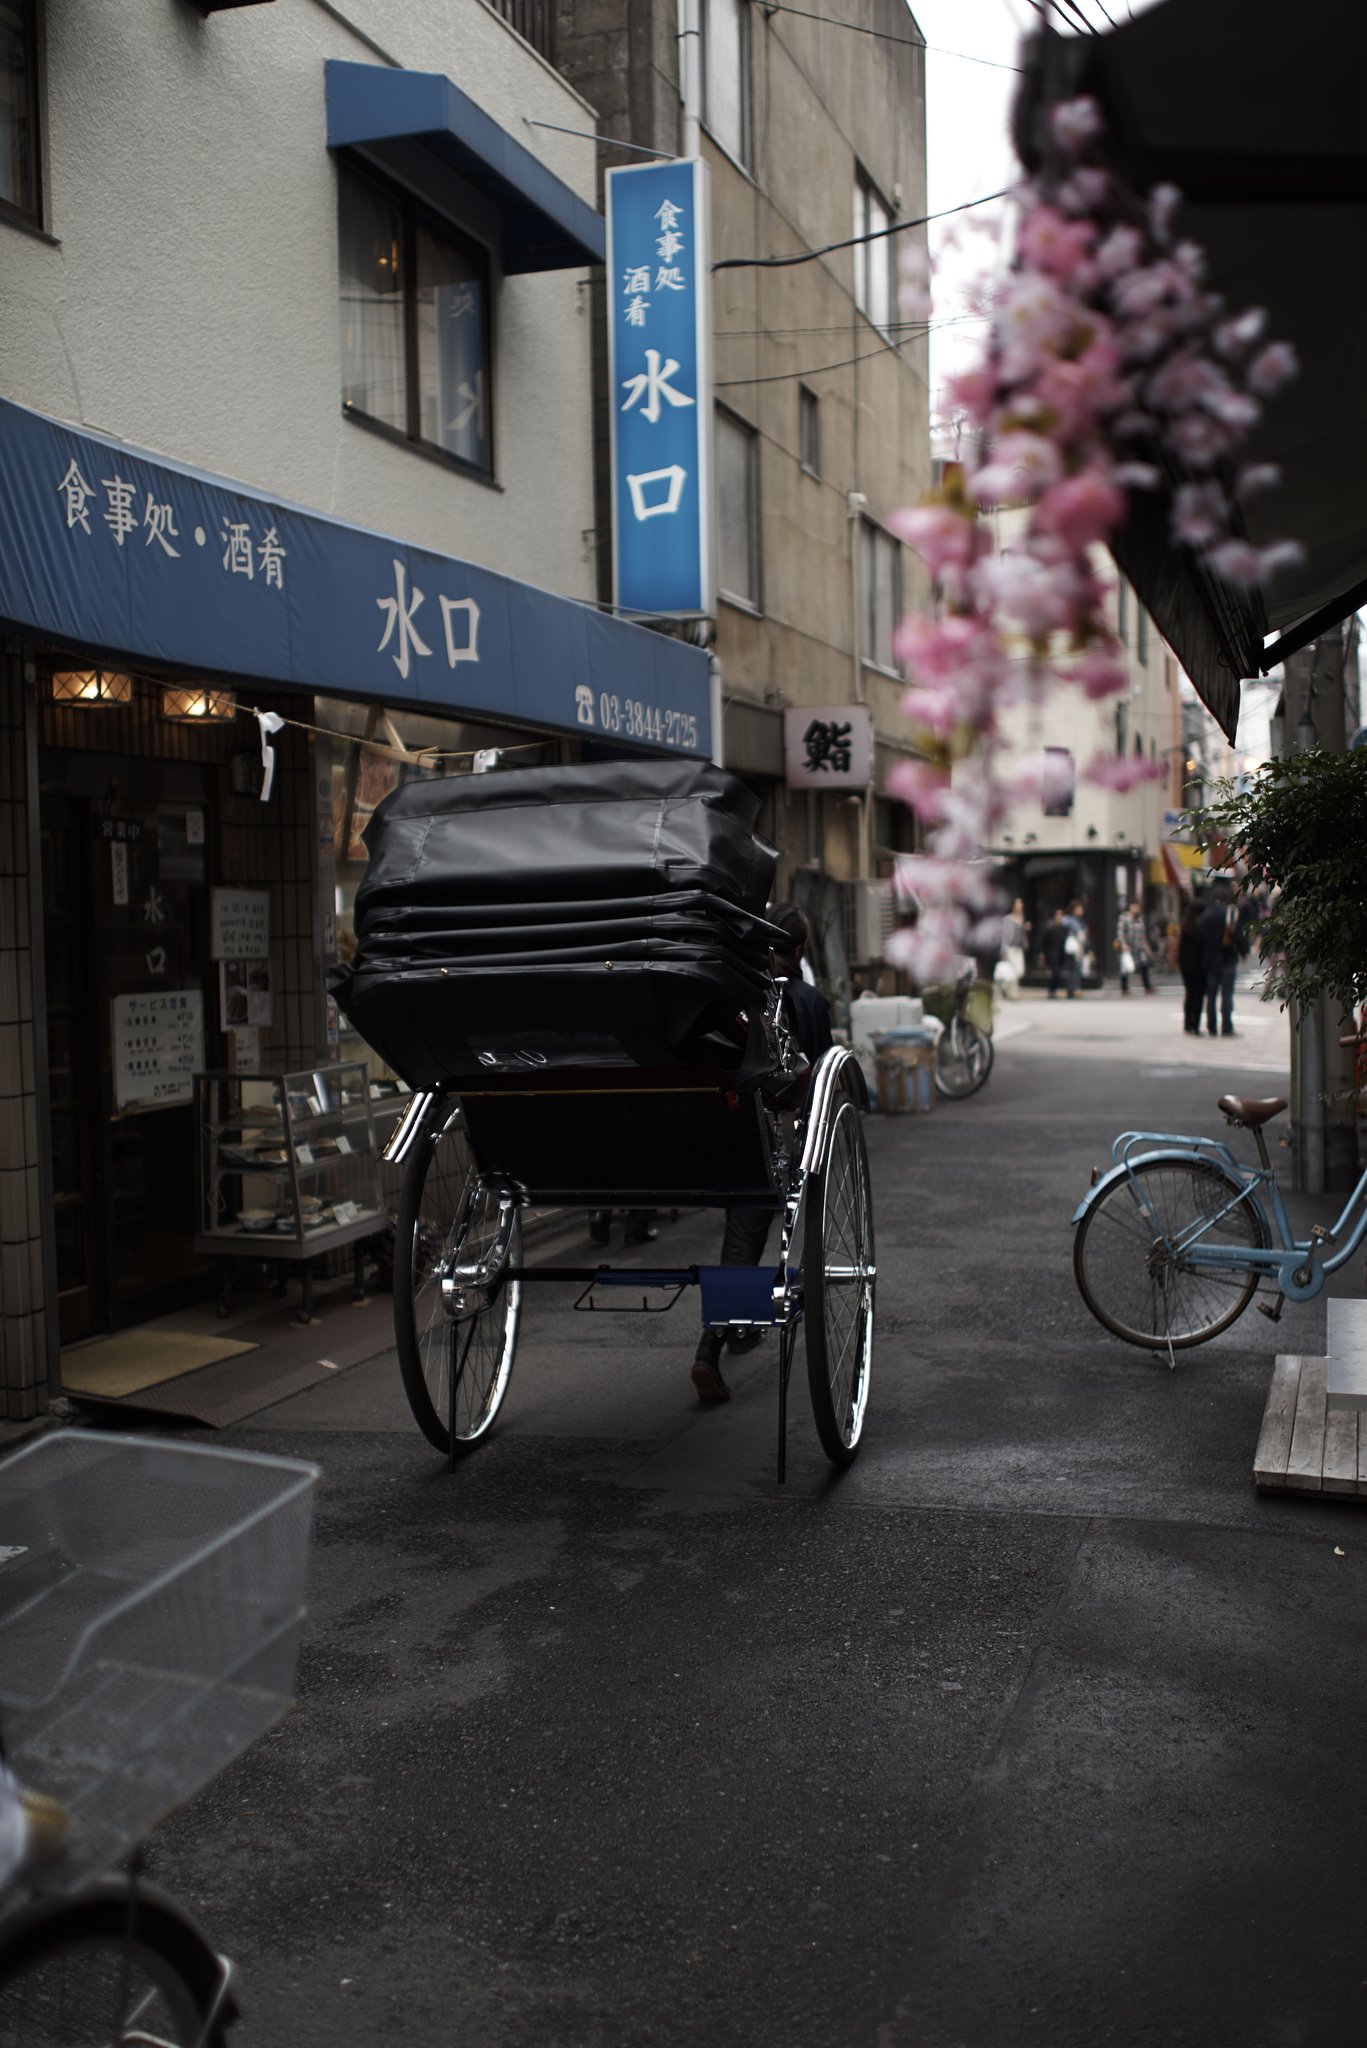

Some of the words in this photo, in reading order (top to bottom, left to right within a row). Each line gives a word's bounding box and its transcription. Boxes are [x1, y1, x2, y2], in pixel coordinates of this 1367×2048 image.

[653, 198, 686, 292] 食事処
[621, 347, 696, 521] 水口
[375, 558, 480, 680] 水口
[600, 692, 697, 749] 03-3844-2725
[802, 719, 852, 773] 鮨
[143, 884, 167, 975] 水口
